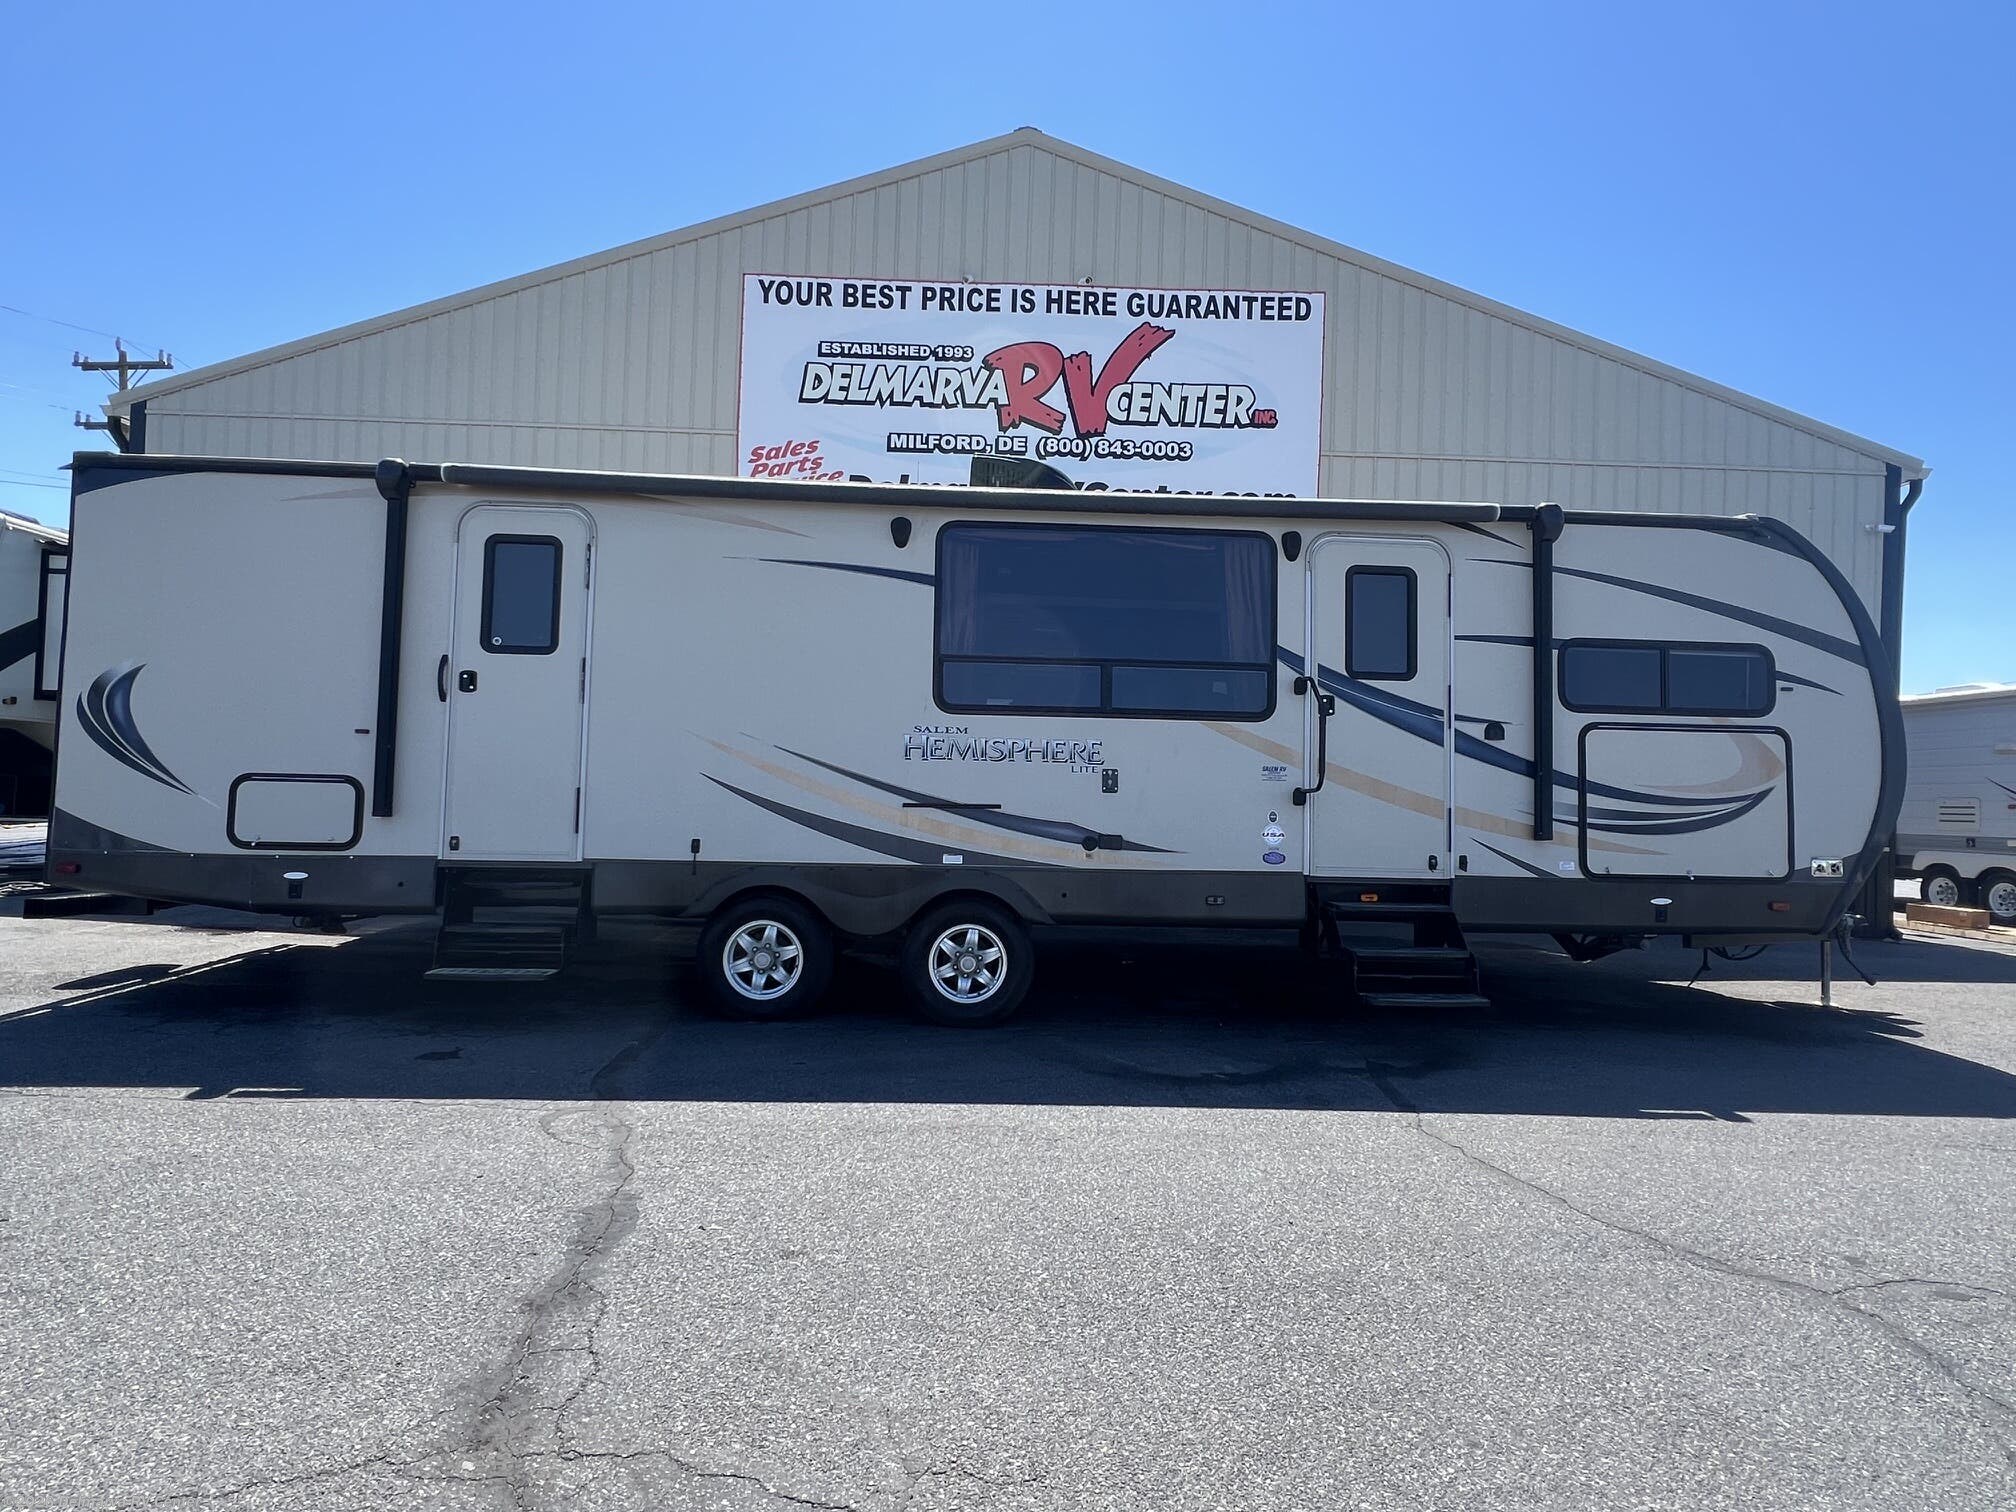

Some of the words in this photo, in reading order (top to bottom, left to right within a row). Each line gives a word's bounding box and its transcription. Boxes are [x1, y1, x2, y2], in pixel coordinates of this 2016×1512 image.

[758, 279, 833, 307] YOUR
[843, 283, 912, 310] BEST
[921, 286, 1001, 313] PRICE
[1011, 289, 1036, 313] IS
[1045, 289, 1118, 316] HERE
[1126, 293, 1312, 321] GUARANTEED
[819, 342, 932, 359] ESTABLISHED
[935, 347, 974, 359] 1993
[799, 362, 1011, 409] DELMARVA
[982, 322, 1176, 438] RV
[1106, 382, 1257, 428] CENTER
[747, 440, 820, 464] Sales
[889, 433, 992, 454] MILFORD,
[996, 436, 1028, 453] DE
[1036, 437, 1092, 461] (800)
[1095, 439, 1193, 461] 843-0003
[750, 456, 824, 477] Parts
[913, 725, 969, 735] SALEM
[903, 734, 1106, 766] HEMISPHERE
[1071, 765, 1099, 773] LITE
